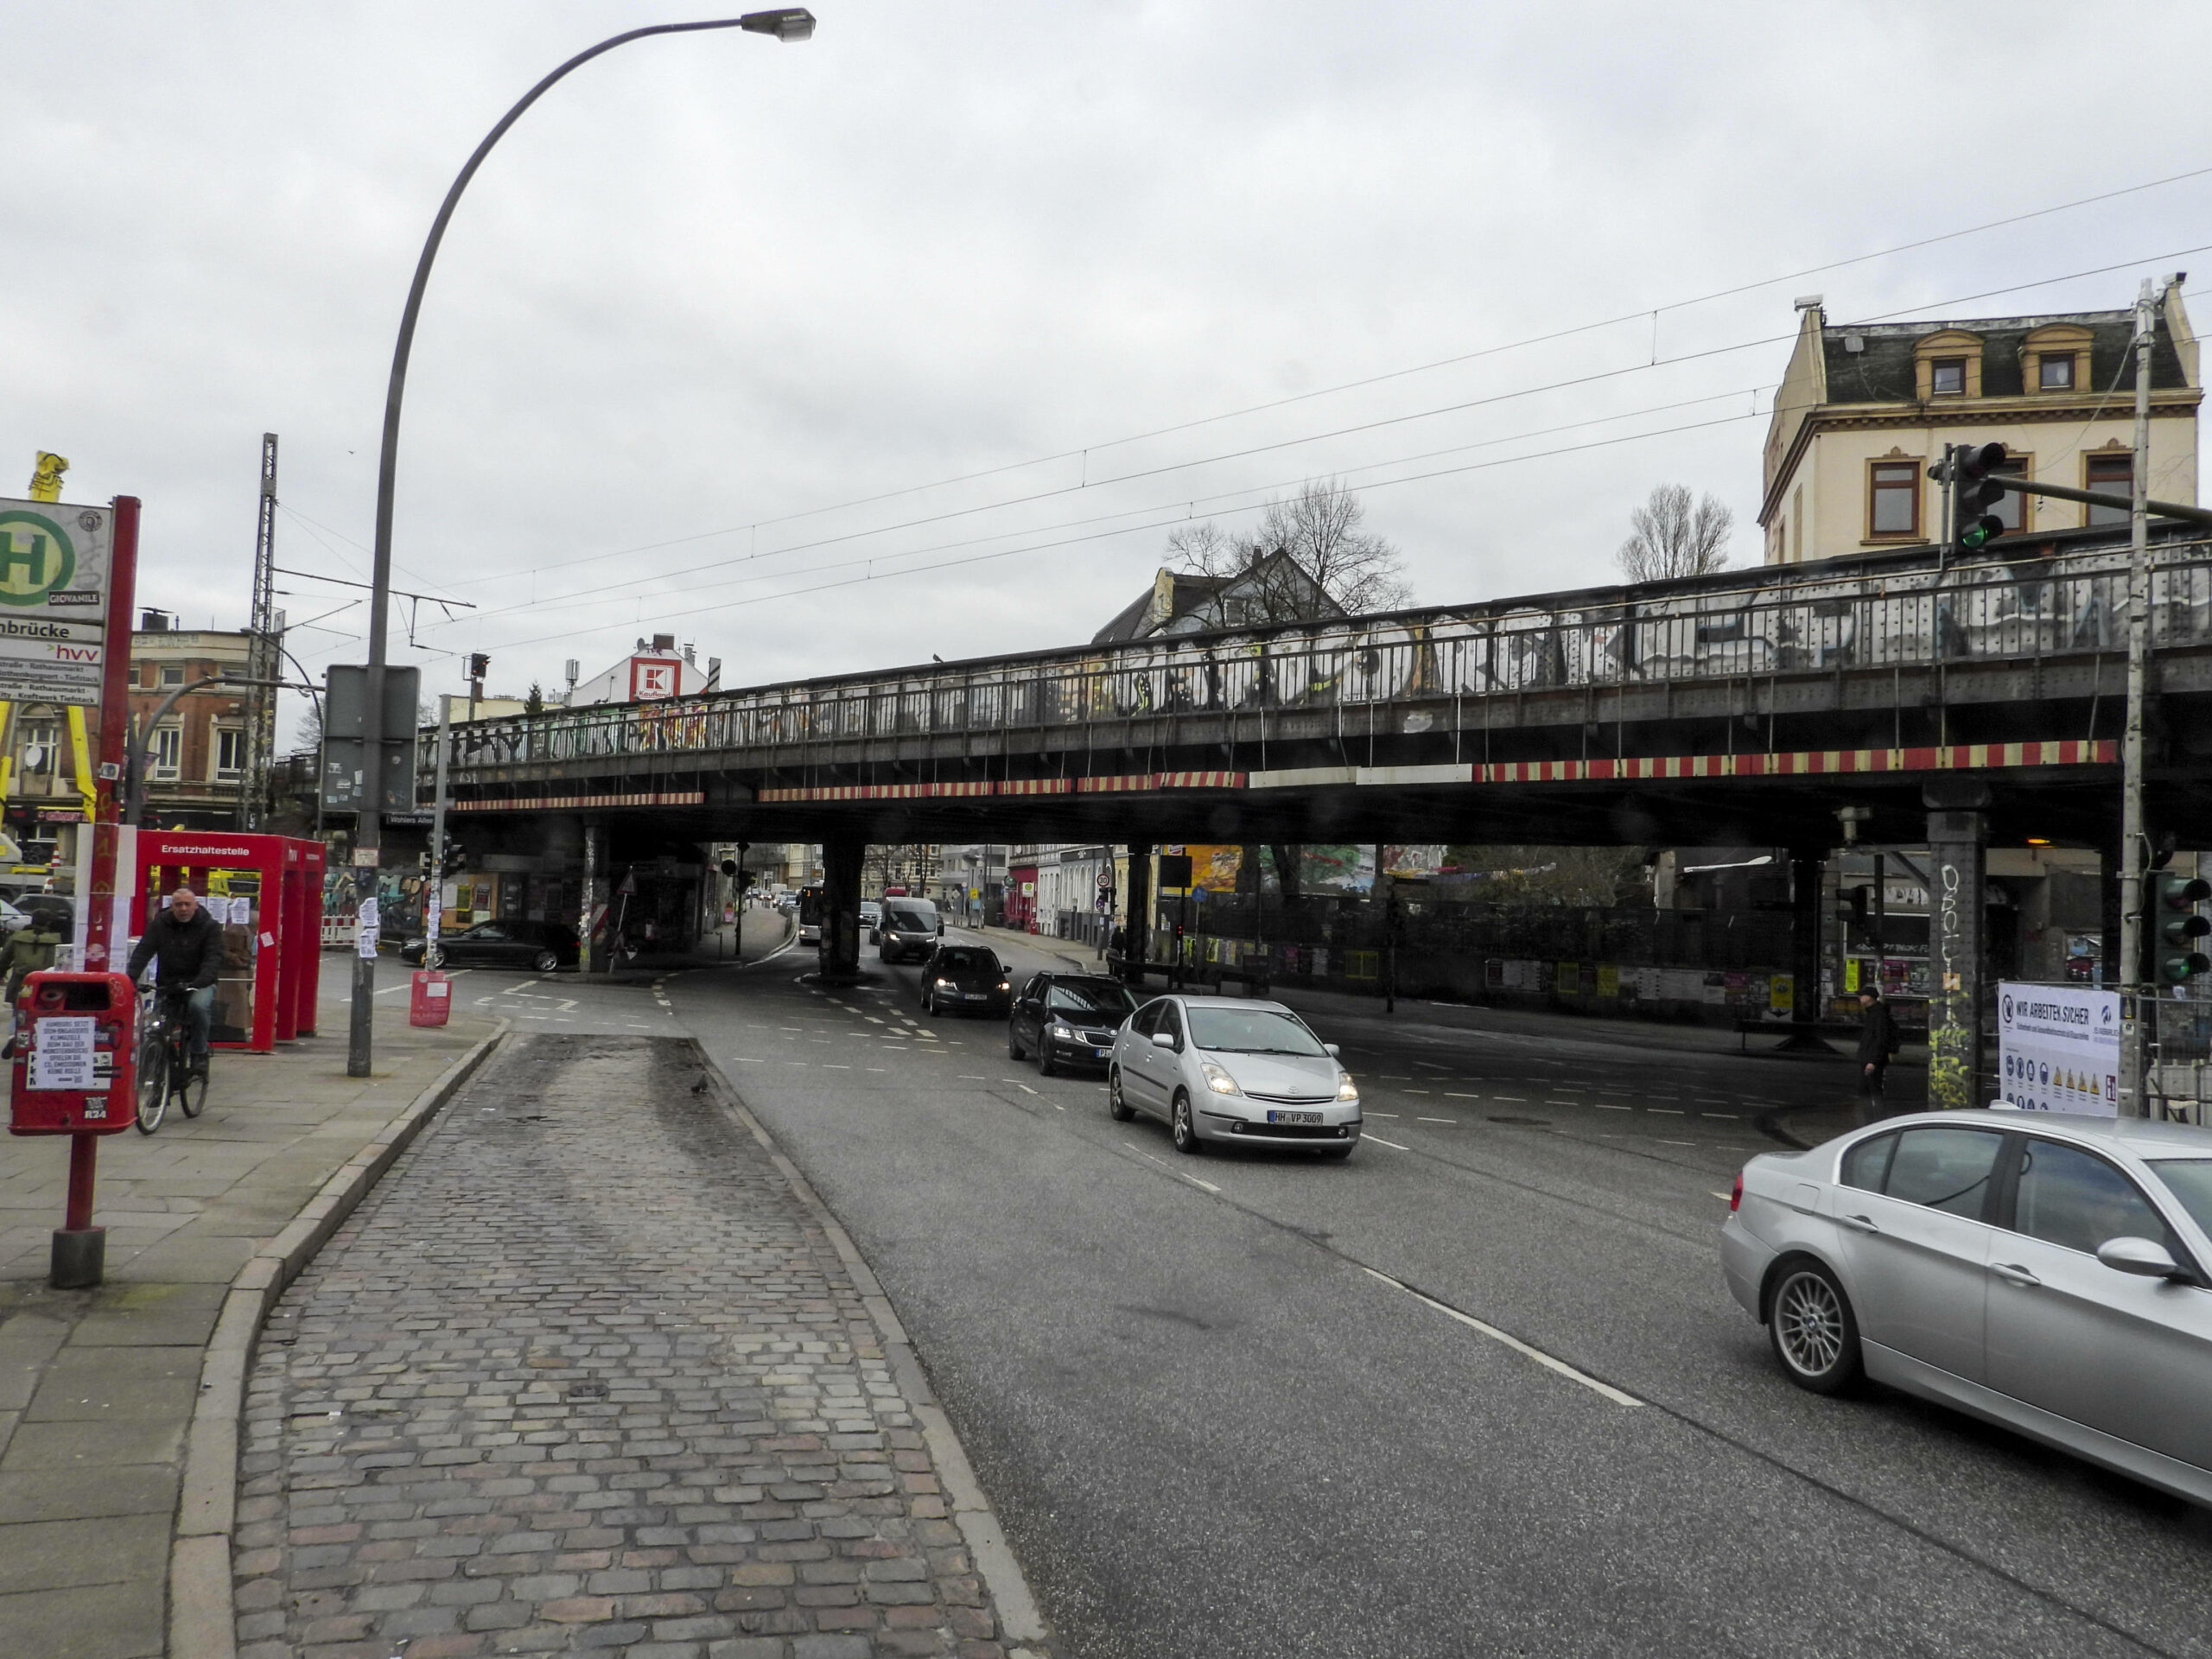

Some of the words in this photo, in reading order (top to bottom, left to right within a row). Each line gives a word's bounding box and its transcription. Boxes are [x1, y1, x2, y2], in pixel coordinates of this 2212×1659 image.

[49, 594, 98, 603] GIOVANILE
[57, 645, 99, 661] hvv
[29, 663, 84, 672] Rathausmarkt
[65, 674, 98, 683] Tiefstack
[29, 684, 85, 694] Rathausmarkt
[18, 692, 57, 701] Kraftwerk
[60, 695, 96, 703] Tiefstack
[162, 844, 250, 856] Ersatzhaltestelle
[2016, 1001, 2028, 1017] WIR
[2030, 1002, 2062, 1022] ARBEITEN
[2063, 1006, 2089, 1026] SICHER
[1275, 1112, 1286, 1122] HH
[1291, 1113, 1301, 1122] VP
